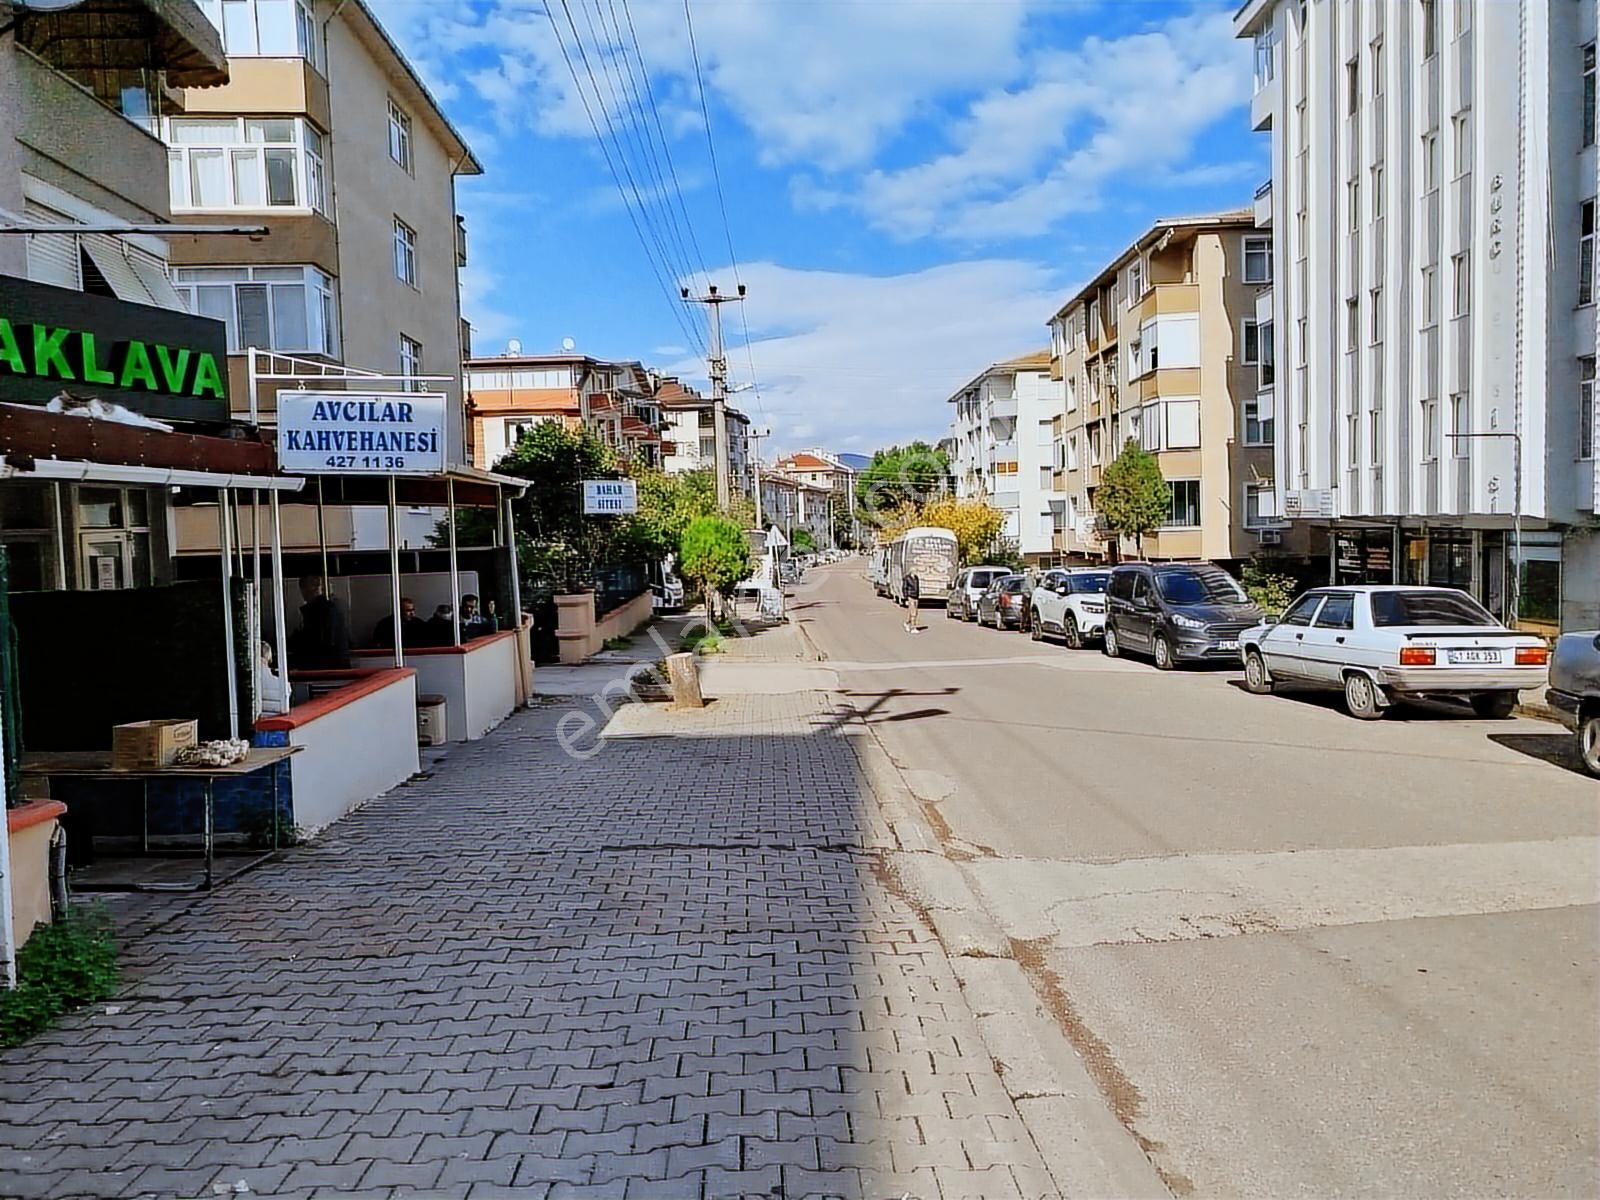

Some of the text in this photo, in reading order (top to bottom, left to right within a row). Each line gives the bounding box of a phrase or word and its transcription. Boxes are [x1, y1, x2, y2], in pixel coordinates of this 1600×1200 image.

[312, 401, 413, 423] AVCILAR
[286, 428, 438, 453] KAHVEHANESİ
[326, 455, 356, 468] 427
